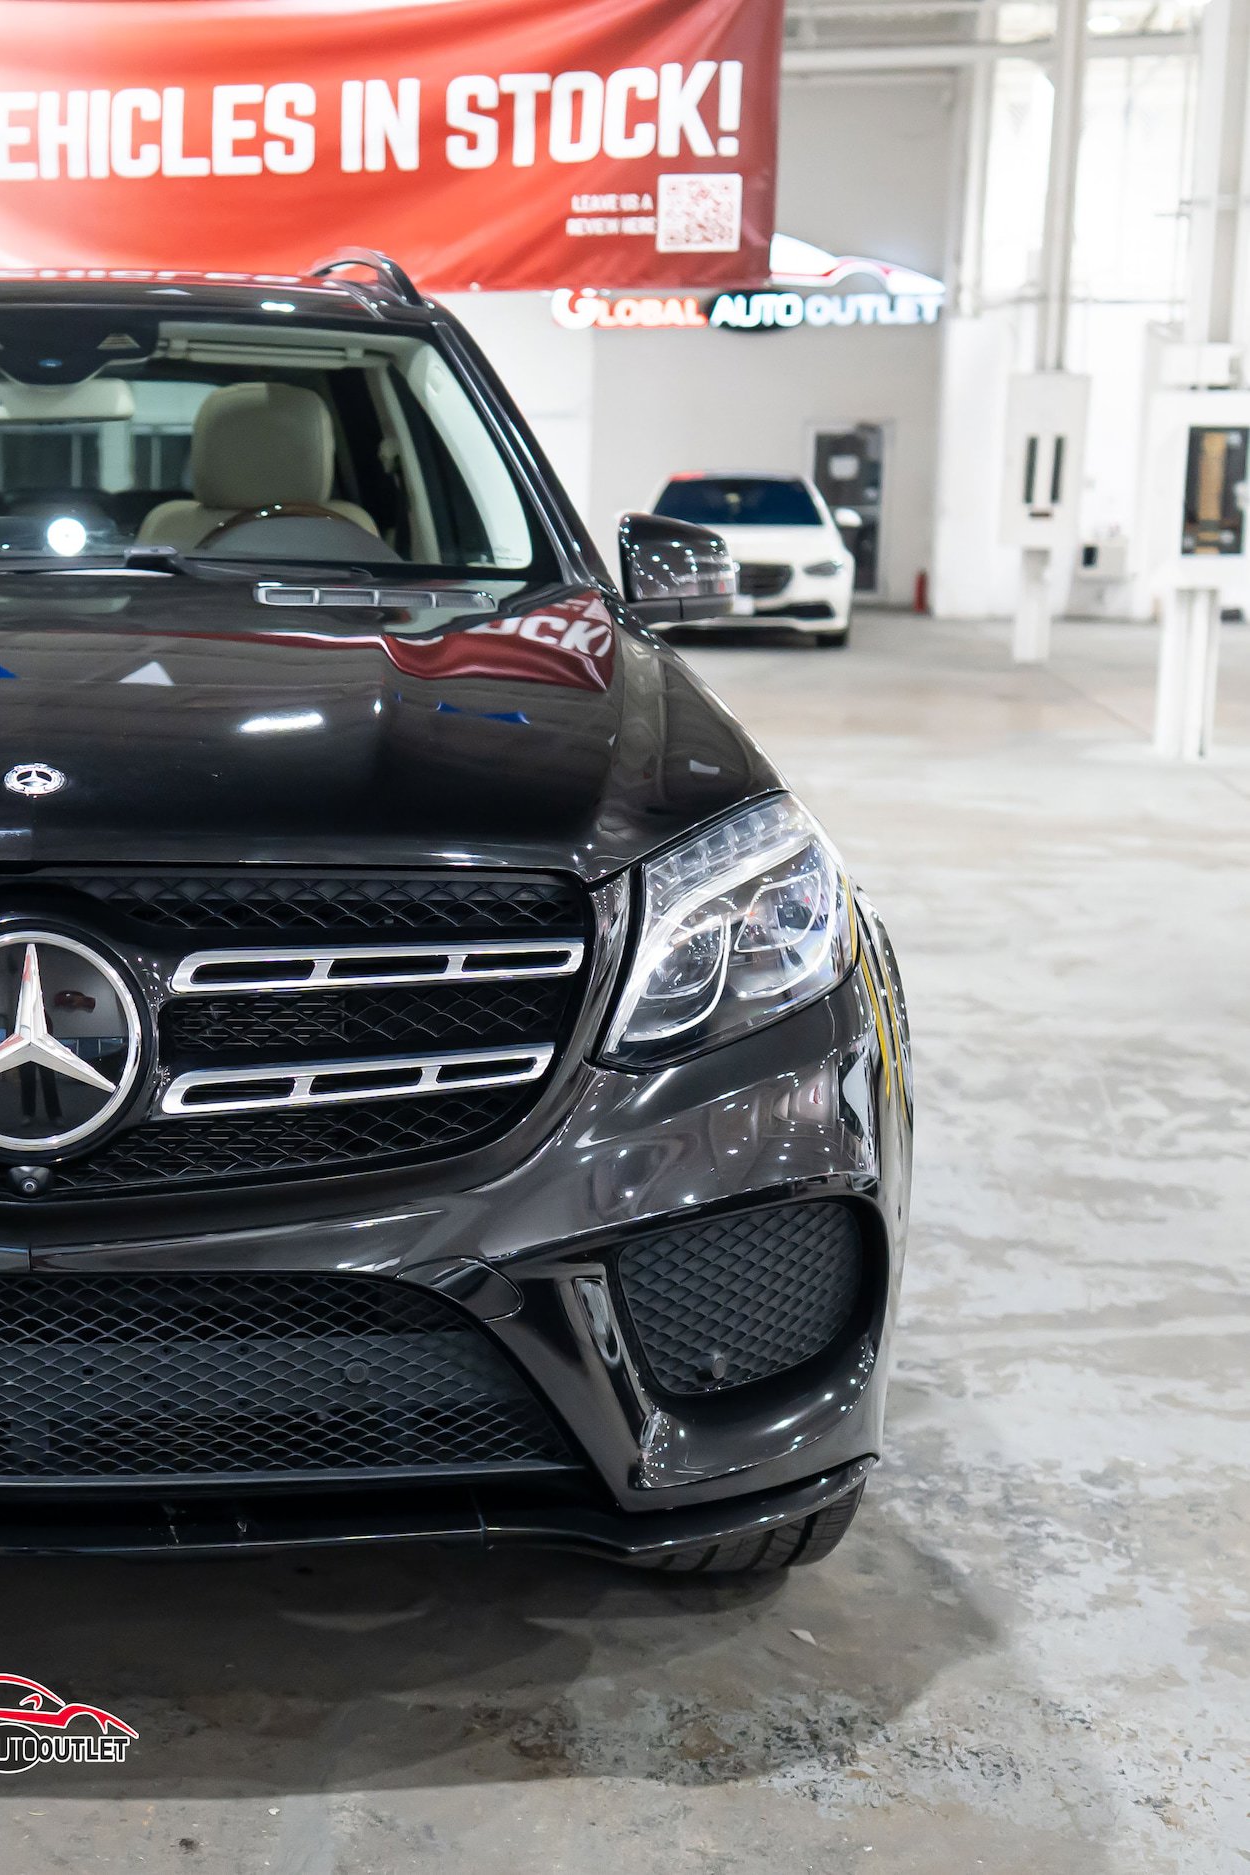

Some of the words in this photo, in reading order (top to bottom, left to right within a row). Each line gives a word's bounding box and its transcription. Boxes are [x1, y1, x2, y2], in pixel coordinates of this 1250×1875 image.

[342, 79, 421, 173] IN
[446, 60, 743, 169] STOCK!
[551, 289, 707, 330] GLOBAL
[709, 292, 805, 329] AUTO
[805, 295, 941, 326] OUTLET
